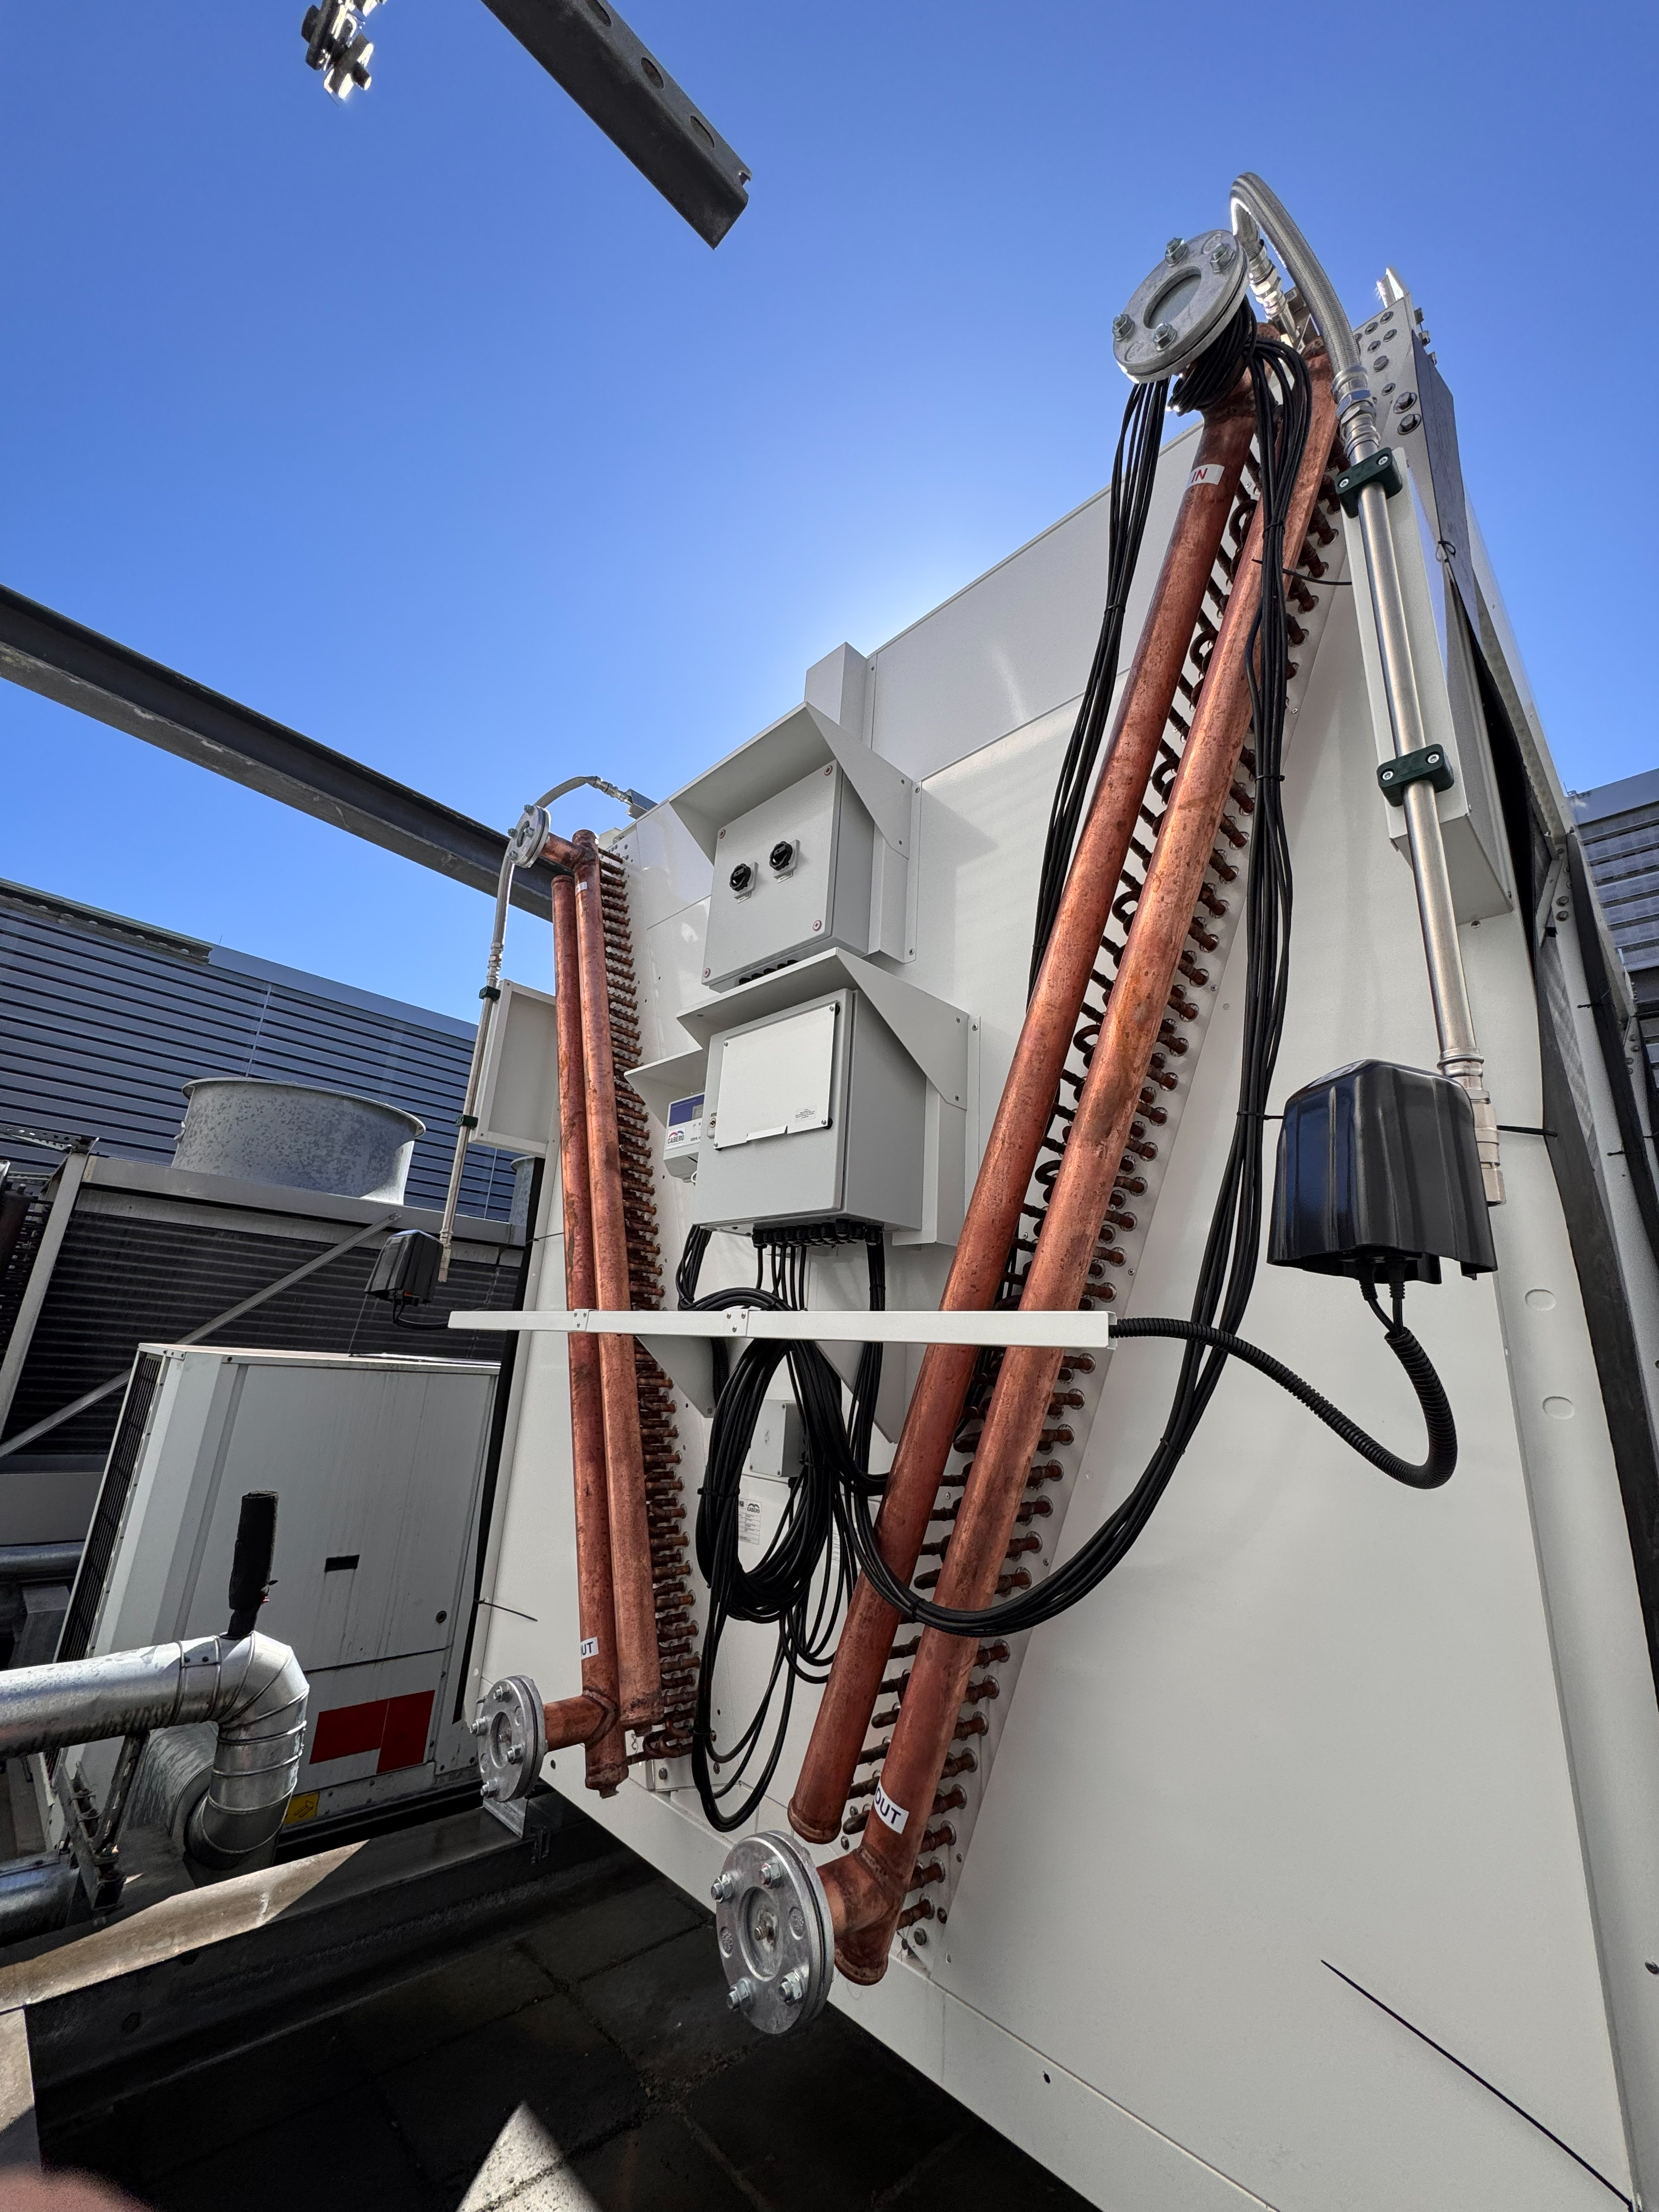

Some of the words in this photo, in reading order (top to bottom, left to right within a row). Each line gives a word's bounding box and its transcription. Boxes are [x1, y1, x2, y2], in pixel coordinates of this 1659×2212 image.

[1191, 467, 1208, 483] IN
[668, 1135, 684, 1144] CABERO
[580, 1641, 593, 1655] UT
[876, 1787, 901, 1825] OUT
